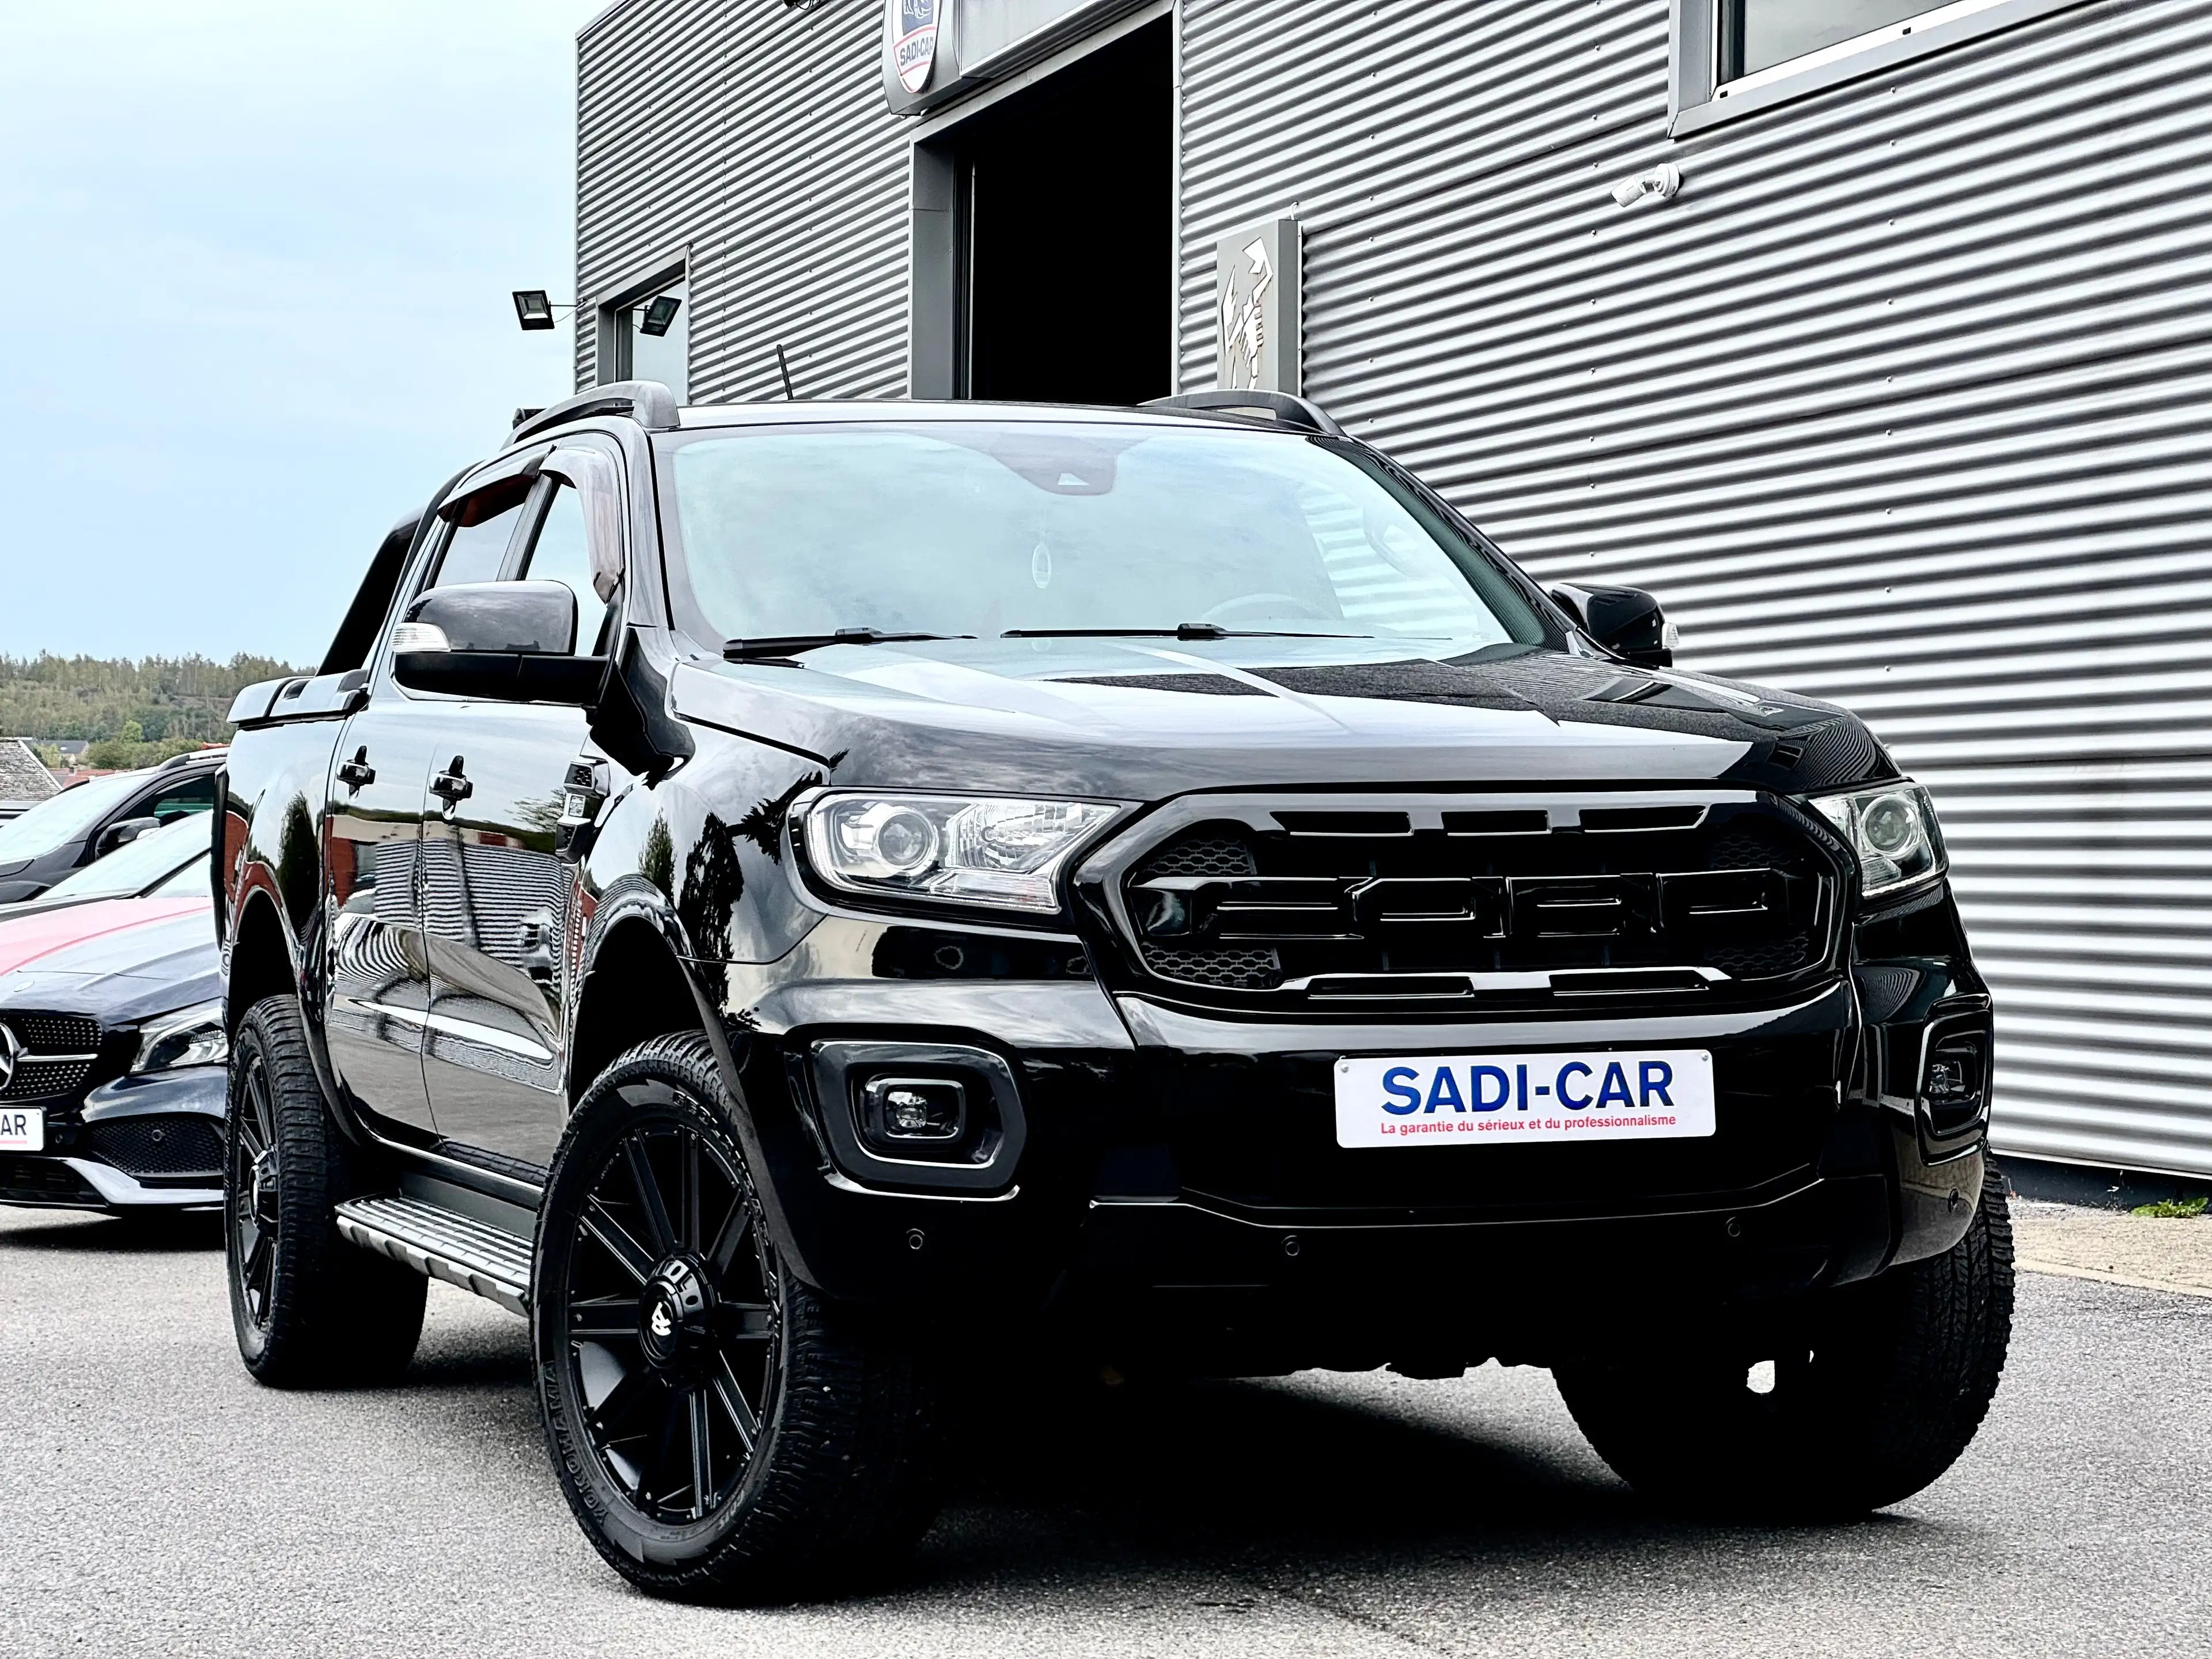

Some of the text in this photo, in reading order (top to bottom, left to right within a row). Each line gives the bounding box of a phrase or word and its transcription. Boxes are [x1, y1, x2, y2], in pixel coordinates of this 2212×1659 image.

[1381, 1060, 1675, 1115] SADI-CAR
[1380, 1115, 1676, 1136] La garantie du sérieux et du professionnalisme
[543, 1359, 608, 1527] YOKOHAMA
